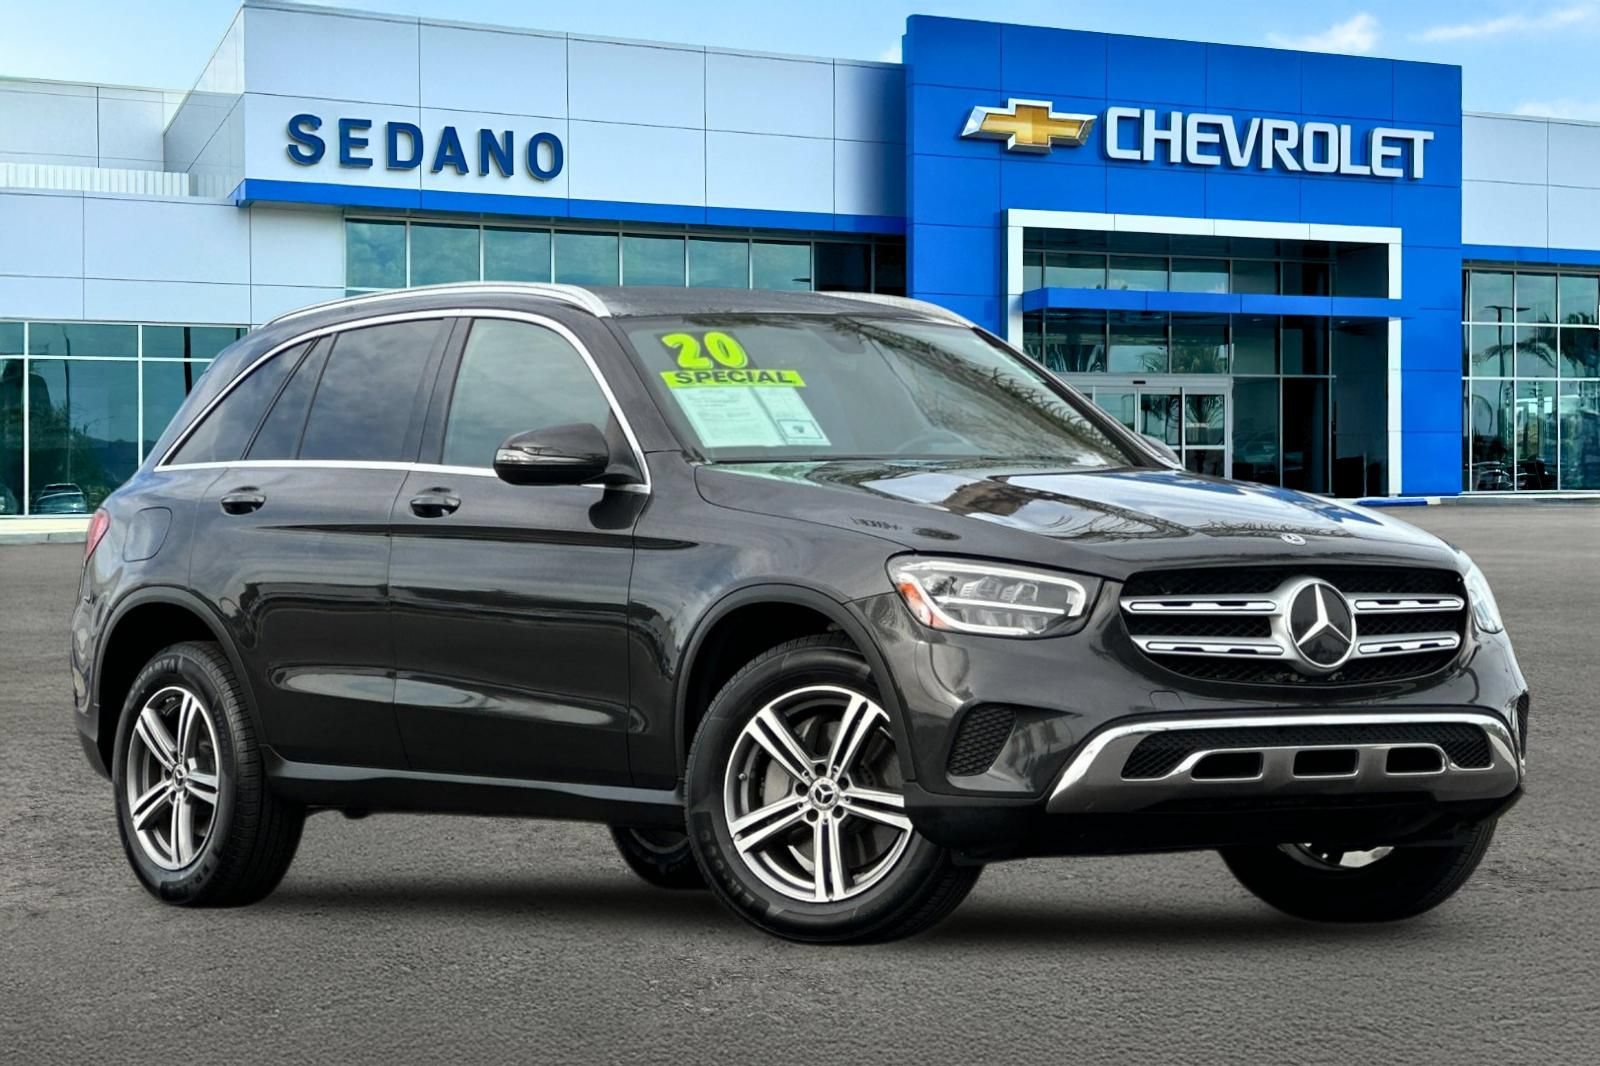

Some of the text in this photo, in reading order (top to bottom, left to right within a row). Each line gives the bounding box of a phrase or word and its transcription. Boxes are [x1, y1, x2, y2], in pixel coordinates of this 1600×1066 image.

[287, 114, 564, 181] SEDANO
[1105, 107, 1435, 179] CHEVROLET
[662, 331, 748, 370] 20
[675, 370, 794, 384] SPECIAL
